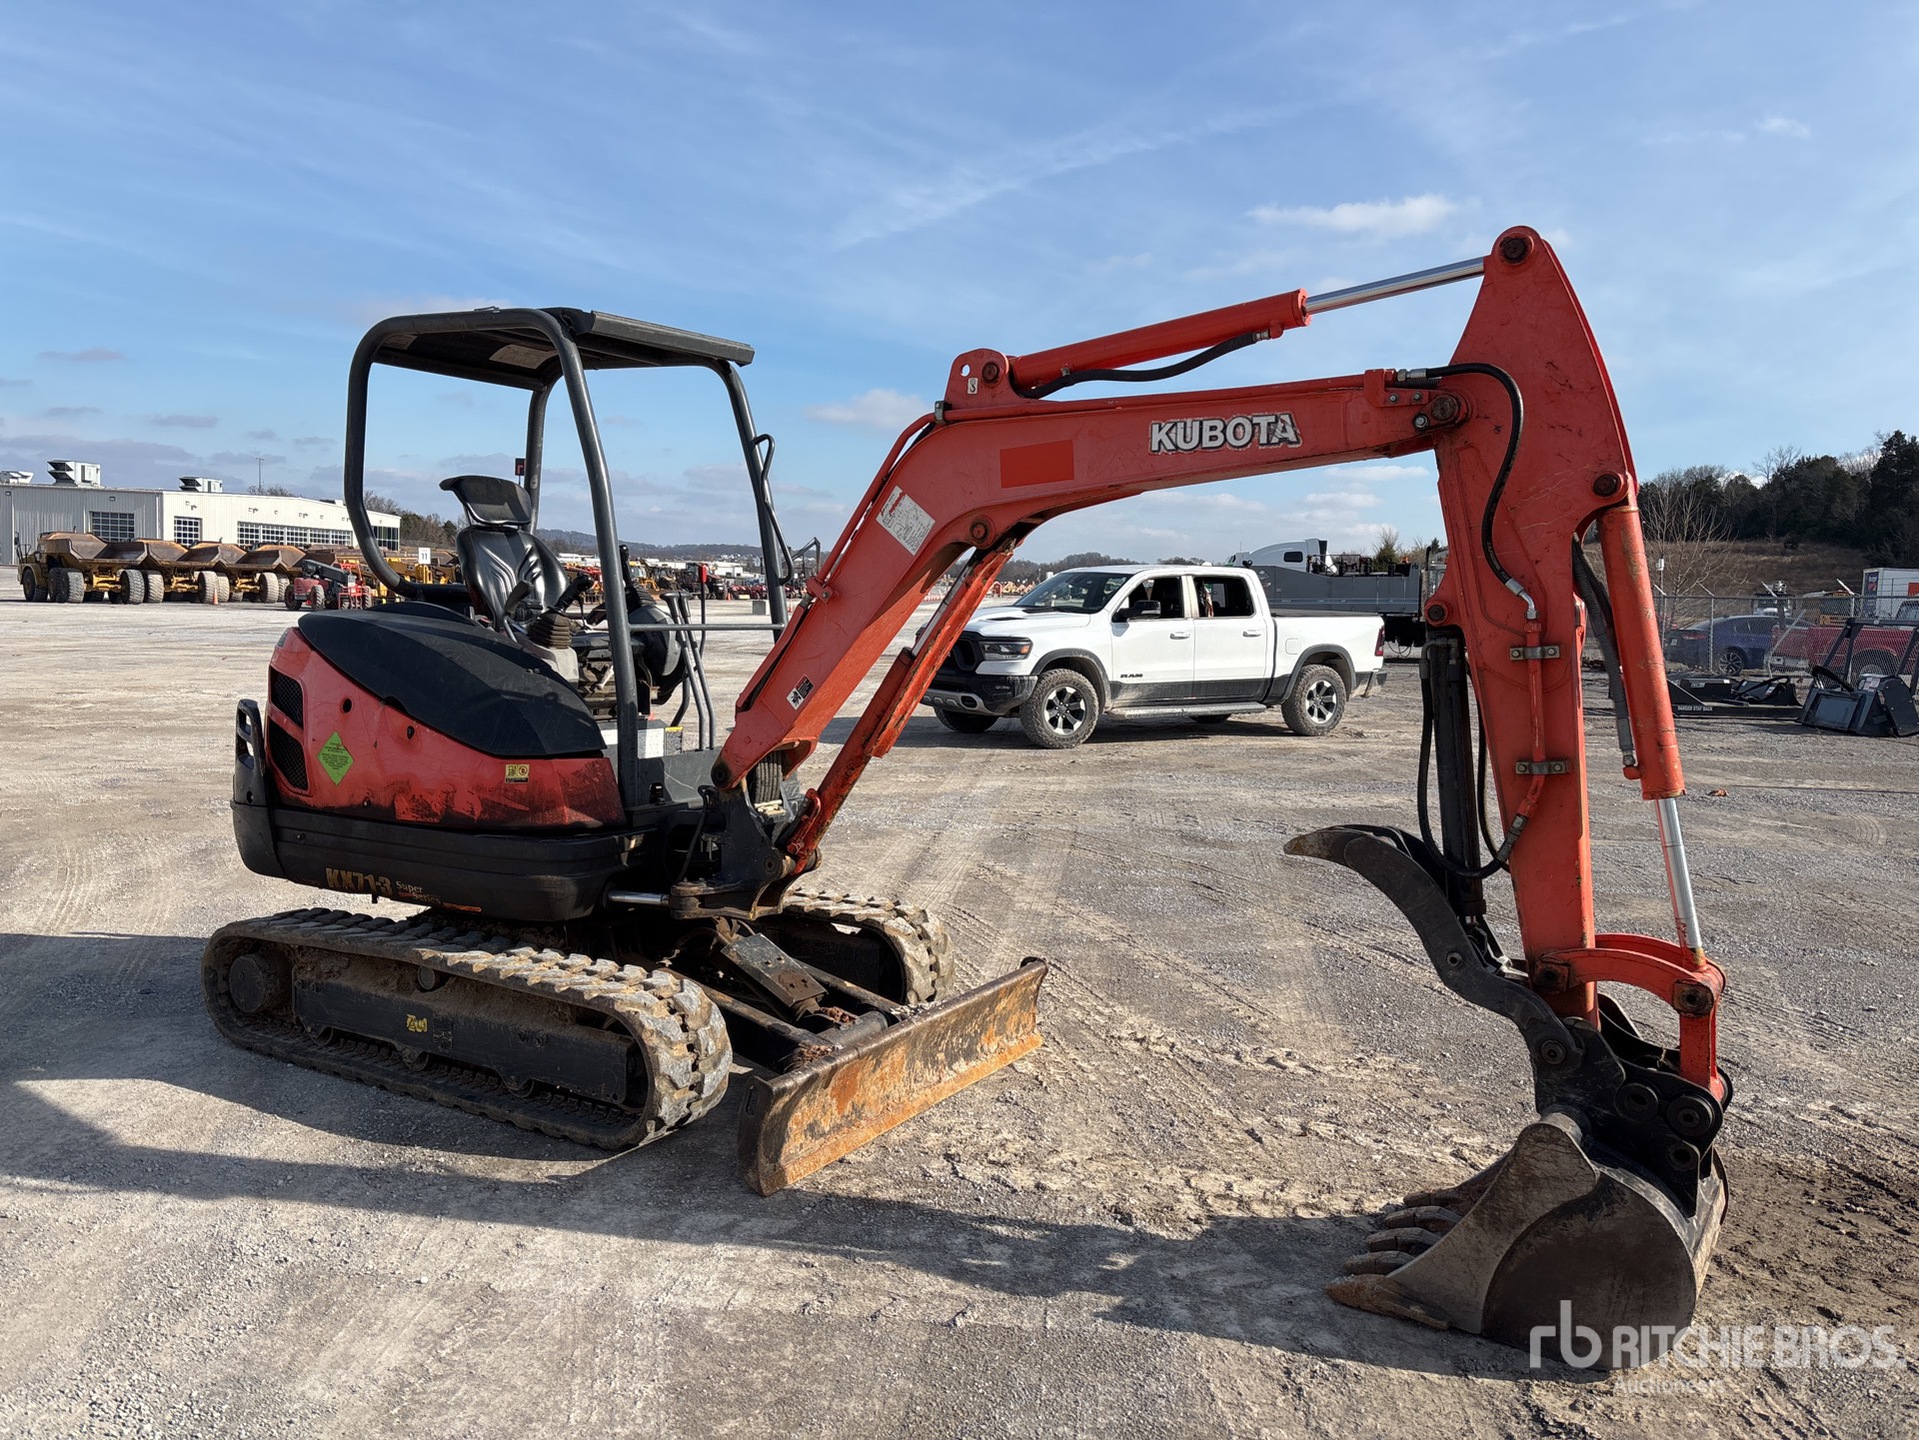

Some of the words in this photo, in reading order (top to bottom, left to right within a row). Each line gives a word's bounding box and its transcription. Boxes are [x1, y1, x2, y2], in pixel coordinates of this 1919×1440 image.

[1151, 413, 1300, 452] KUBOTA
[325, 867, 393, 898] KX71-3
[395, 881, 424, 894] Super
